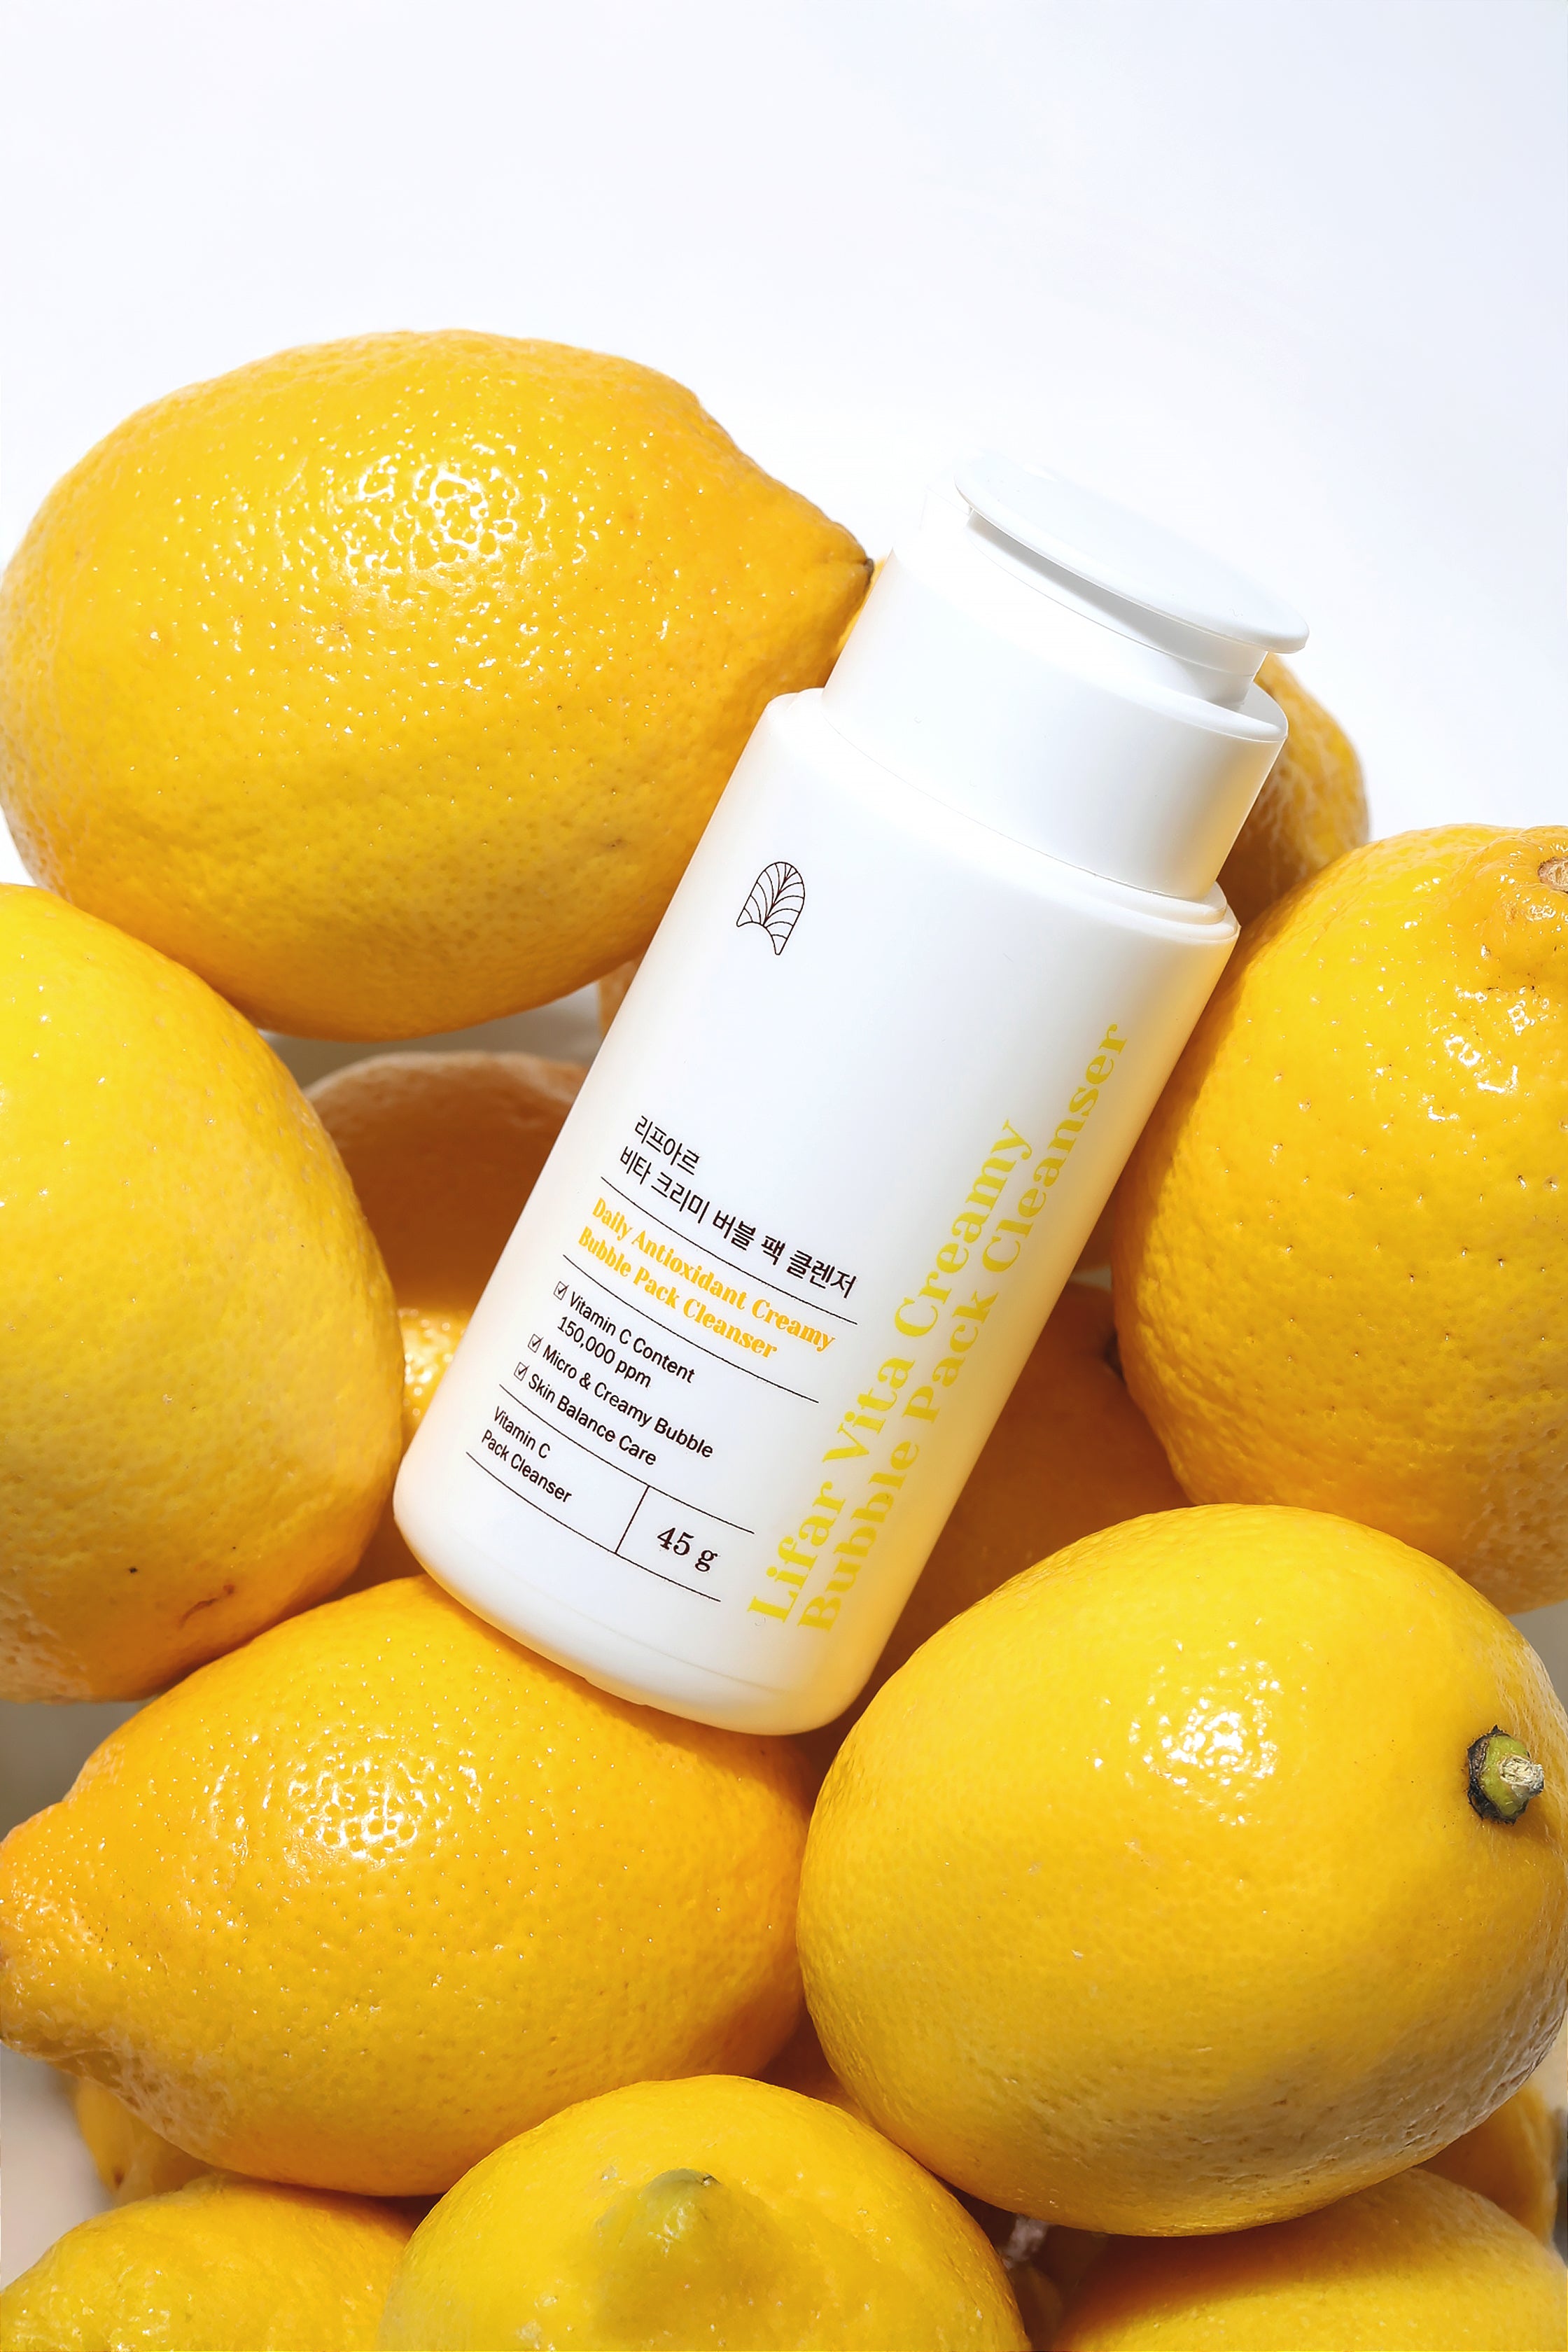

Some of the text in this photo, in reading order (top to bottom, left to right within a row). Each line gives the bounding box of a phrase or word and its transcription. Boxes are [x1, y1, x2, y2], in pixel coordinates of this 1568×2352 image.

[634, 1115, 700, 1175] 리프아르
[620, 1146, 857, 1298] 비타 크리미 버블 팩 클렌저
[578, 1226, 778, 1358] Bubble Pack Cleanser
[592, 1198, 836, 1352] Daily Antioxidant Creamy
[557, 1316, 652, 1388] 150,000 ppm
[569, 1292, 696, 1384] Vitamin C Content
[746, 1118, 1034, 1624] Lifar Vita Creamy
[797, 1023, 1128, 1632] Bubble Pack Cleanser
[494, 1406, 551, 1459] Vitamin C
[528, 1373, 657, 1466] Skin Balance Care
[542, 1344, 713, 1458] Micro & Creamy Bubble
[481, 1429, 572, 1503] Pack Cleanser
[657, 1527, 718, 1572] 45 g
